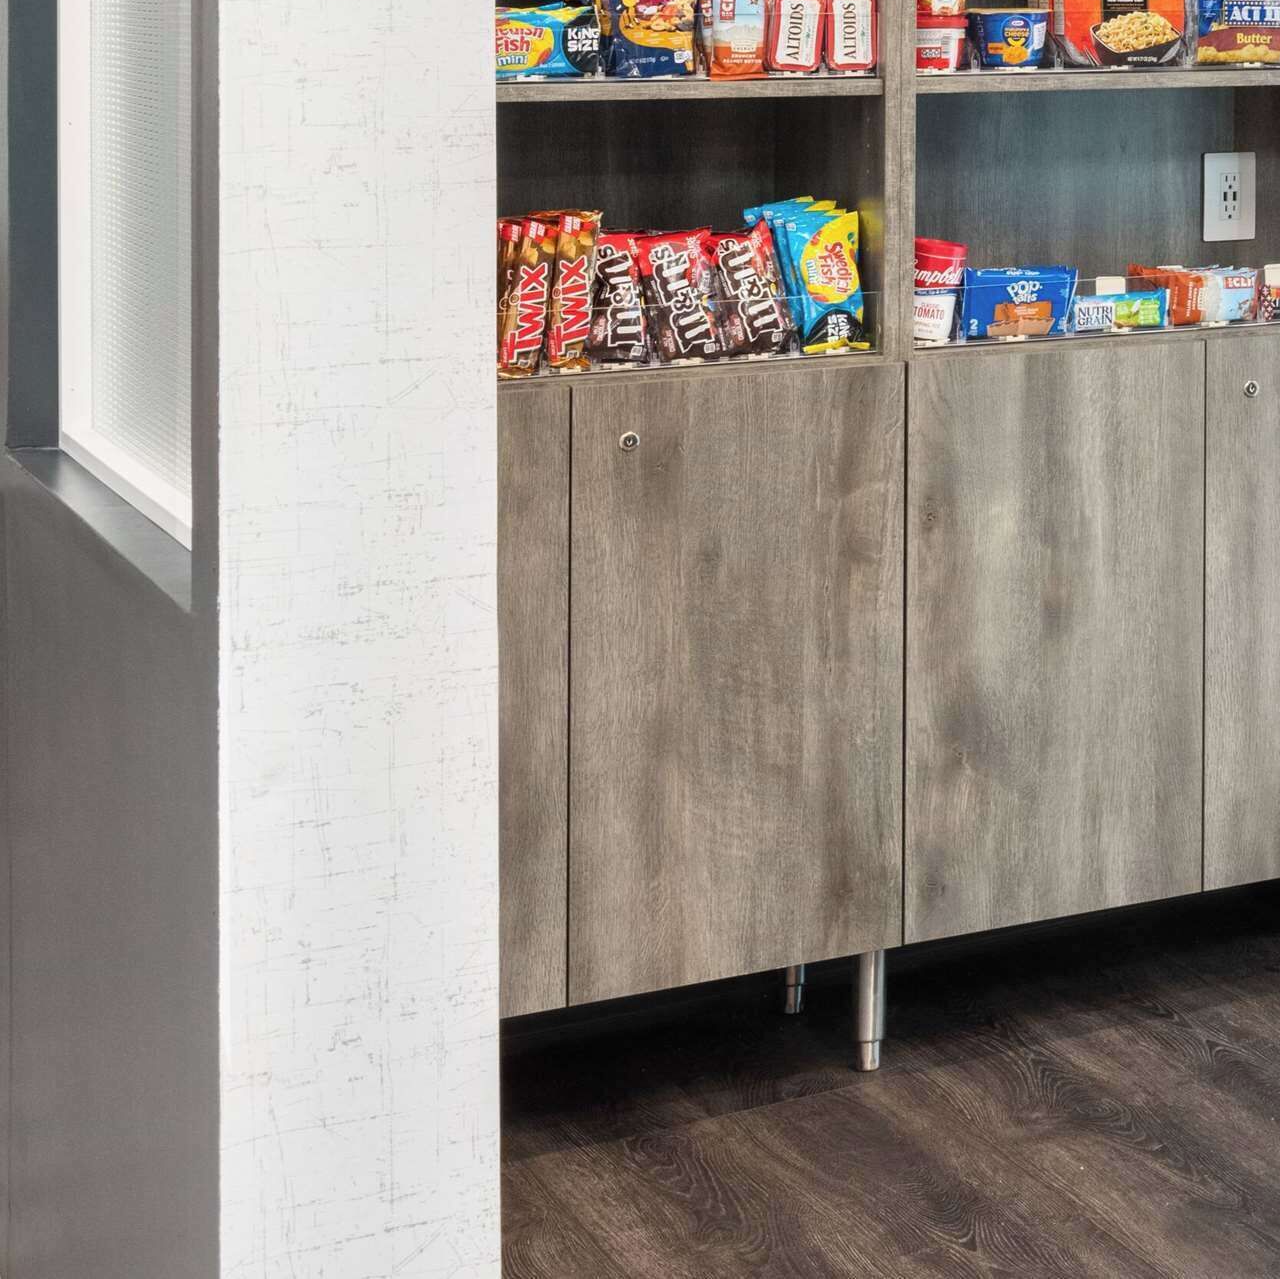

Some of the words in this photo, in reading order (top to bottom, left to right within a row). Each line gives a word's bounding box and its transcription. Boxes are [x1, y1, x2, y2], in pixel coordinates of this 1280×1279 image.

[1230, 6, 1260, 21] ACT
[785, 3, 804, 61] ALTOIDS
[843, 2, 857, 59] ALTOIDS
[1237, 33, 1272, 44] Butter
[914, 306, 945, 319] TOMATO
[1078, 307, 1113, 317] NUTRI
[969, 319, 978, 329] 2
[1077, 316, 1113, 327] GRAIN
